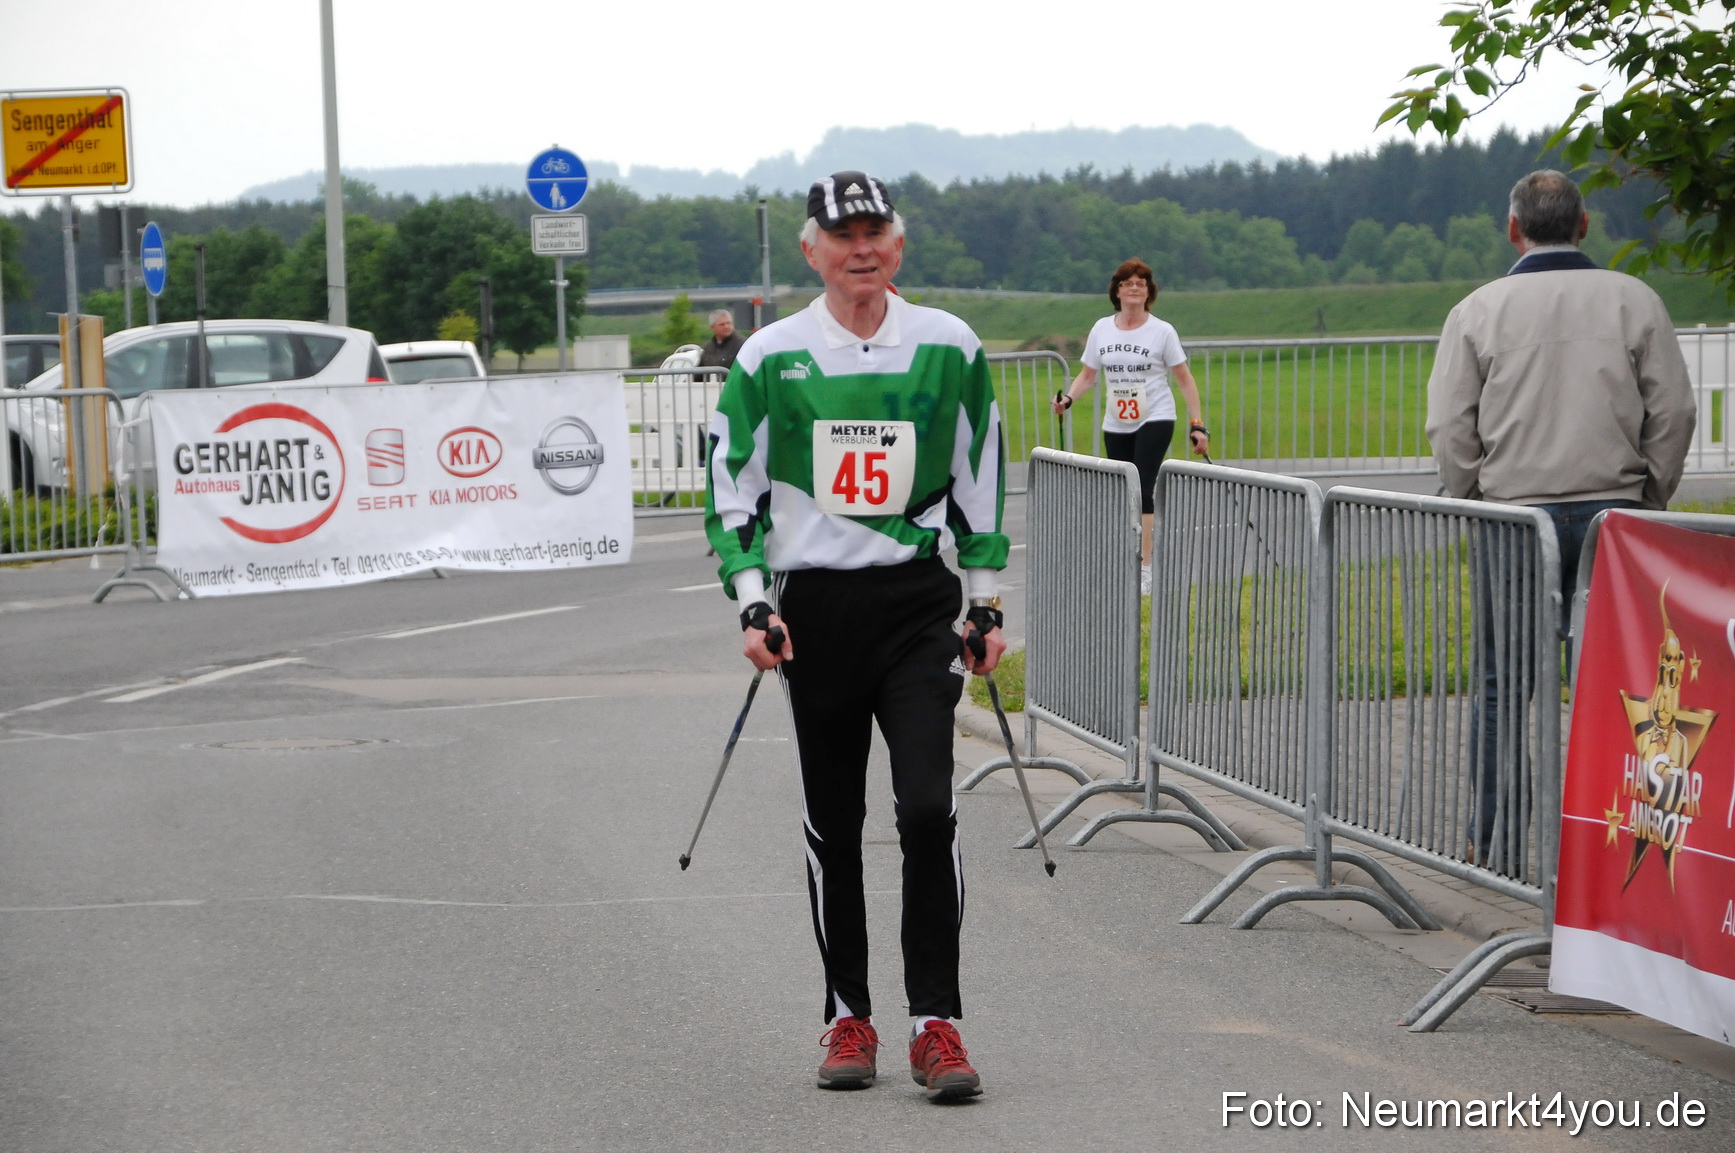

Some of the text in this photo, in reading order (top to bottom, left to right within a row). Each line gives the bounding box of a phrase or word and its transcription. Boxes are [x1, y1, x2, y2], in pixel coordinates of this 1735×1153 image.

[11, 105, 113, 136] Sengenthal
[26, 137, 100, 153] am Anger
[39, 163, 83, 175] Neumarkt
[1100, 343, 1150, 358] BERGER
[780, 370, 807, 380] PUMA
[1127, 363, 1152, 373] GIRLS
[1117, 399, 1140, 420] 23
[830, 425, 877, 436] MEYER
[830, 436, 878, 445] WERBUNG
[173, 438, 325, 475] GERHART &
[449, 438, 491, 466] KIA
[540, 449, 597, 464] NISSAN
[174, 478, 241, 495] Autohaus
[831, 451, 889, 506] 45
[238, 469, 331, 506] JÄNIG
[429, 483, 518, 506] KIA MOTORS
[357, 494, 418, 511] SEAT
[174, 565, 236, 588] Neumarkt
[246, 558, 320, 586] Sengenthal
[330, 556, 354, 577] Tel.
